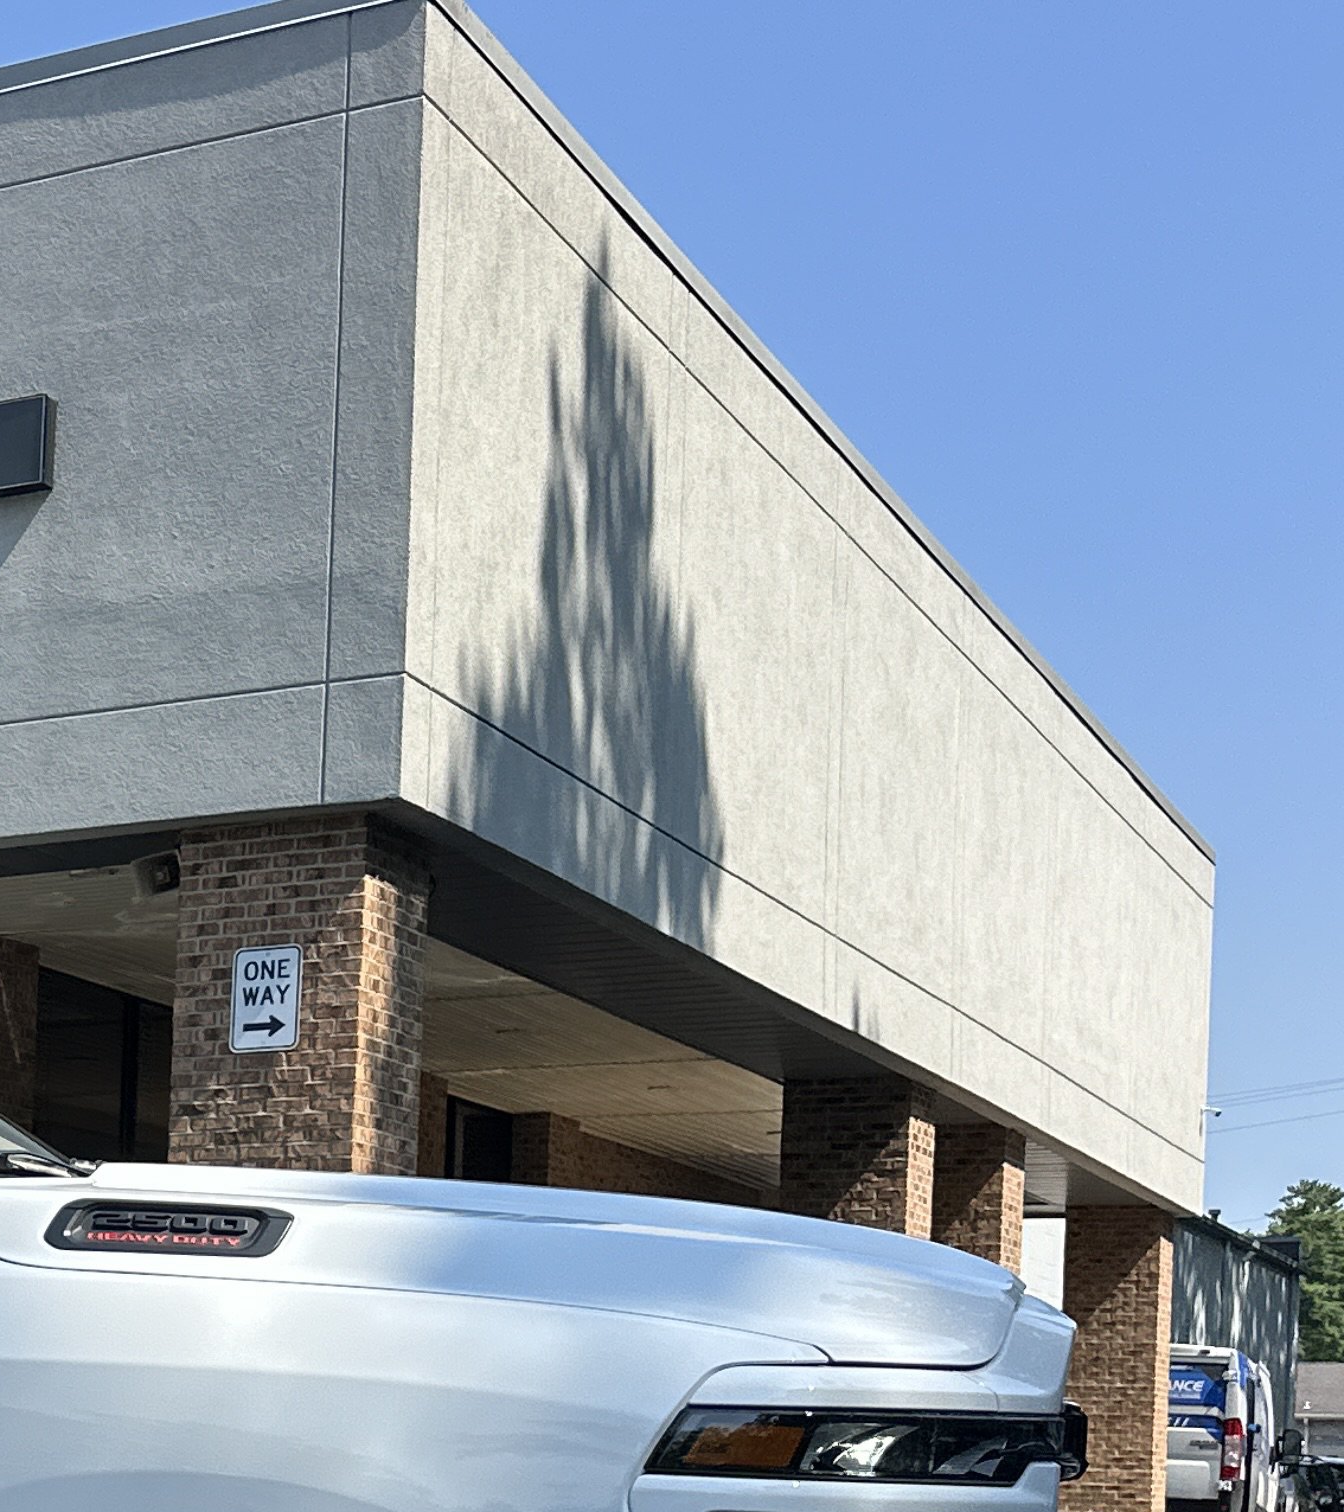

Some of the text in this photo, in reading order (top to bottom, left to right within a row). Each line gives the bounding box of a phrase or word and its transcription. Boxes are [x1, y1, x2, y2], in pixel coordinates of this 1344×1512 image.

[244, 958, 290, 980] ONE
[243, 984, 291, 1006] WAY
[91, 1212, 248, 1236] 2500
[87, 1231, 241, 1247] HEAVY DUTY
